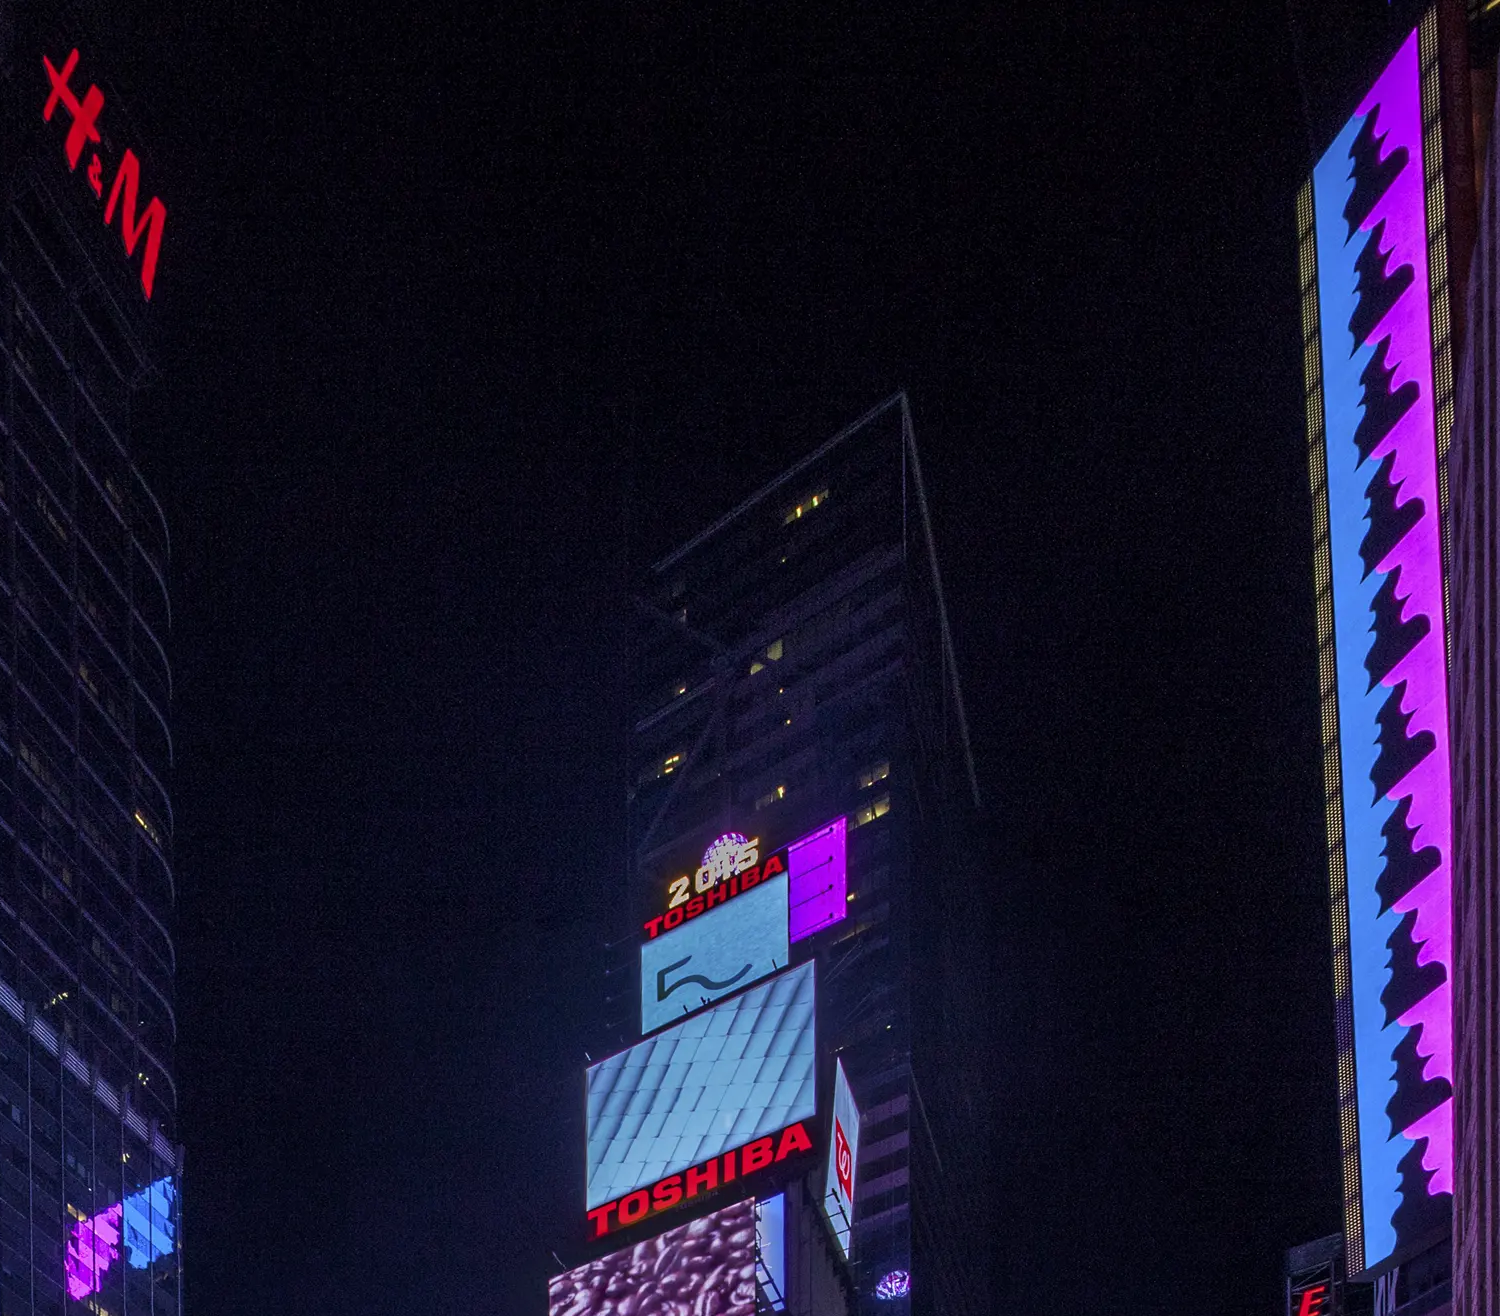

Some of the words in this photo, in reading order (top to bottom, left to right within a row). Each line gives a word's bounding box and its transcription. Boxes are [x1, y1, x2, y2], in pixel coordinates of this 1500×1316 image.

[43, 47, 167, 301] H&M
[644, 855, 783, 939] TOSHIBA
[587, 1122, 812, 1236] TOSHIBA
